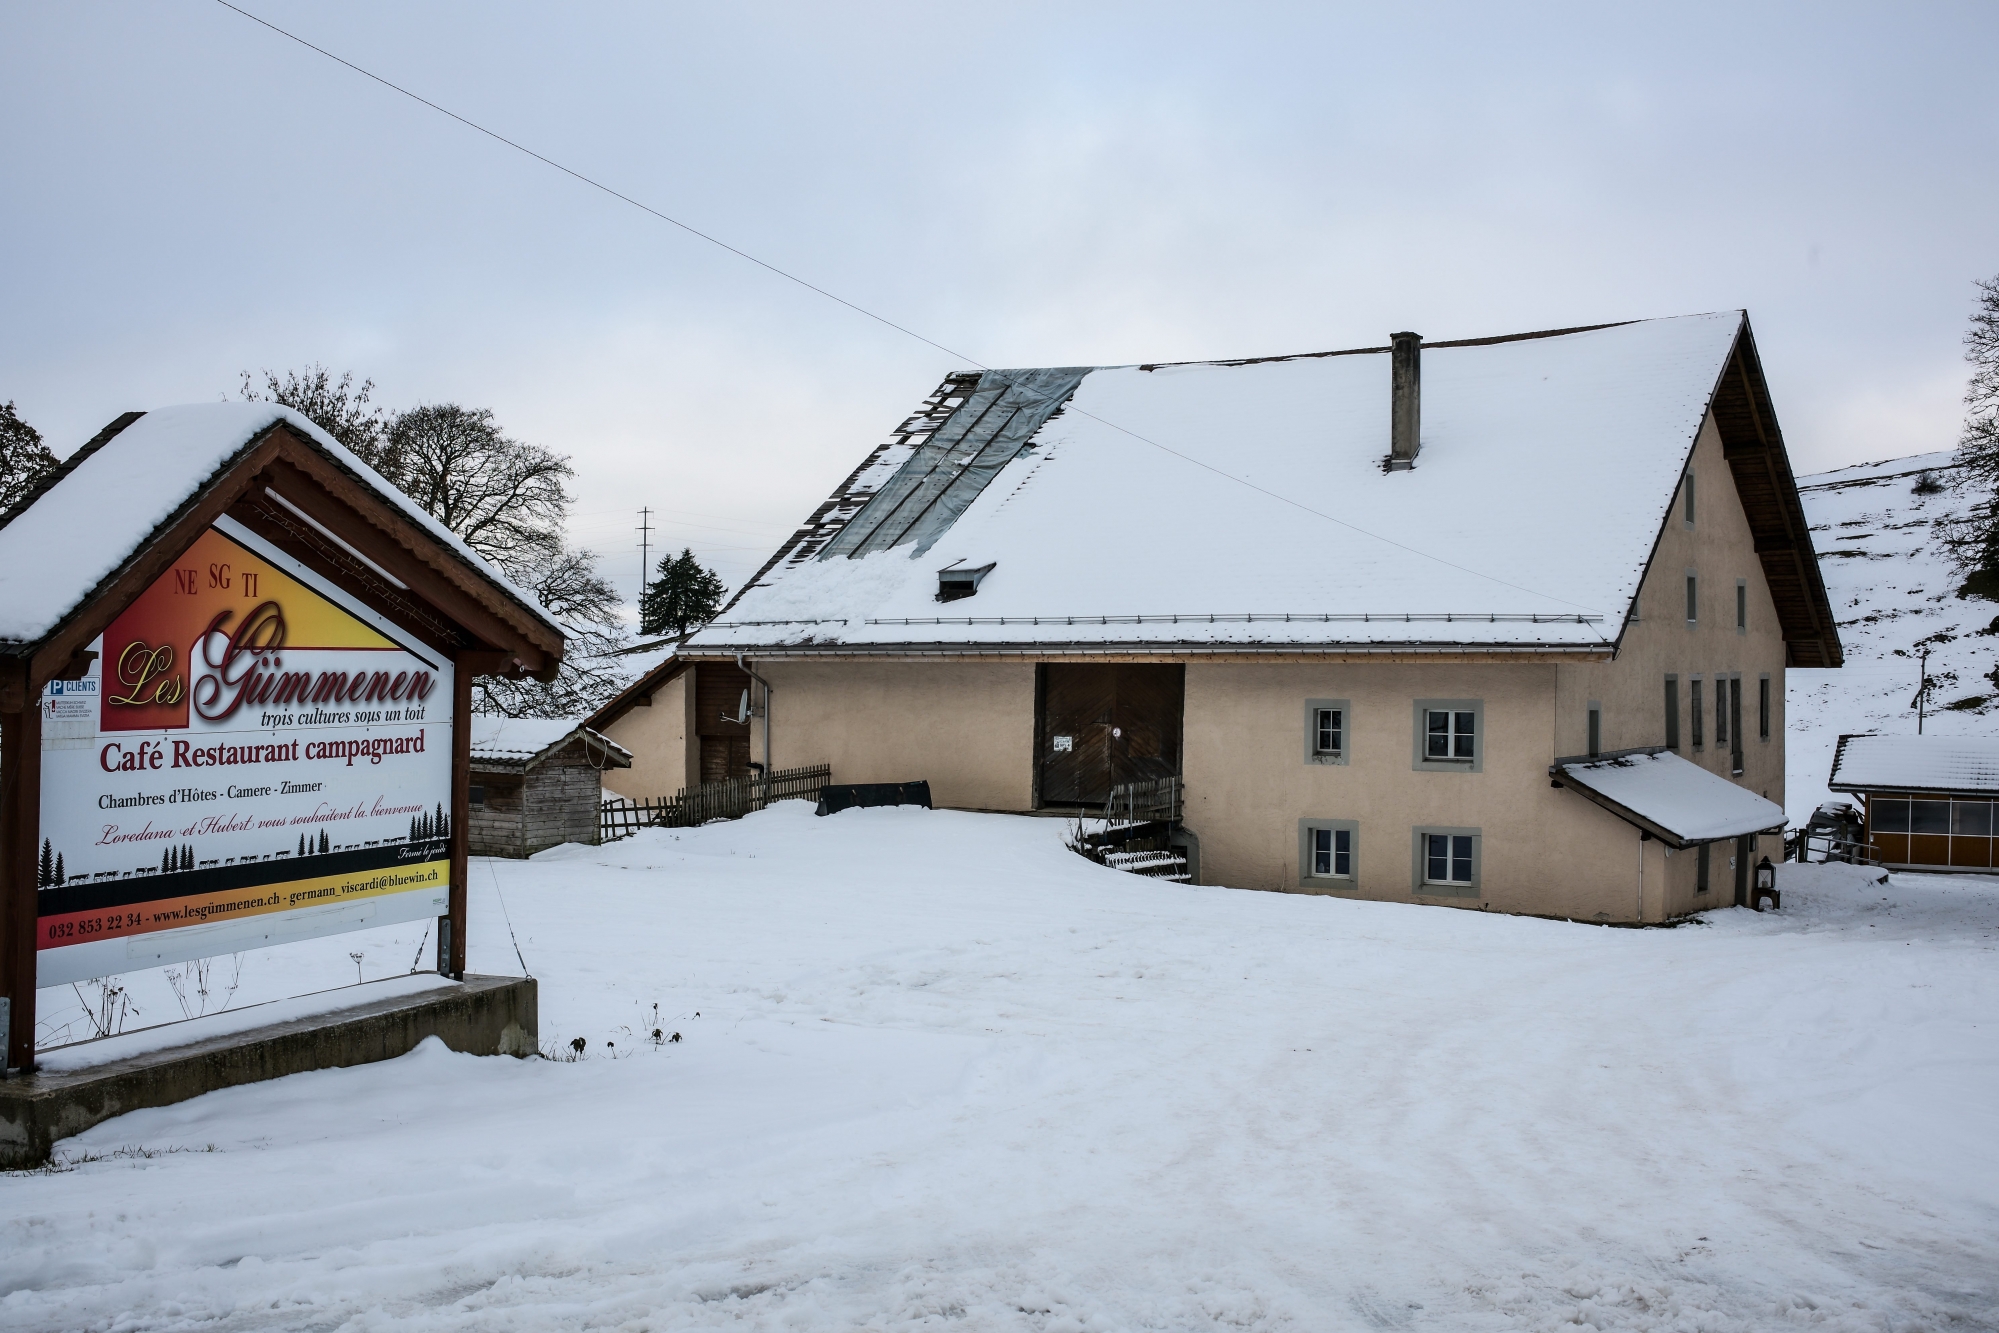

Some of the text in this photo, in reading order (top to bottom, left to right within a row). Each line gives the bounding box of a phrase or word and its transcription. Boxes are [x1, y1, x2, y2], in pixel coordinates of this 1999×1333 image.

[174, 563, 259, 597] NE SG TI
[108, 600, 435, 721] Les Gümmenen
[66, 681, 96, 691] CLIENTS
[261, 704, 426, 727] trois cultures sous un toit
[100, 728, 425, 773] Café Restaurant campagnard
[98, 792, 165, 809] Chambres
[227, 785, 271, 799] Camere
[280, 780, 322, 795] Zimmer
[95, 795, 423, 845] Loredana et Hubert vous souhaitent la bienvenue
[398, 842, 447, 862] Fermé le jeudi
[48, 922, 73, 939] 032
[78, 918, 102, 935] 853
[107, 915, 122, 931] 22
[126, 912, 142, 927] 34
[153, 892, 280, 923] www.lesgümmenen.ch
[289, 868, 438, 906] germann_viscardi@bluewin.ch
